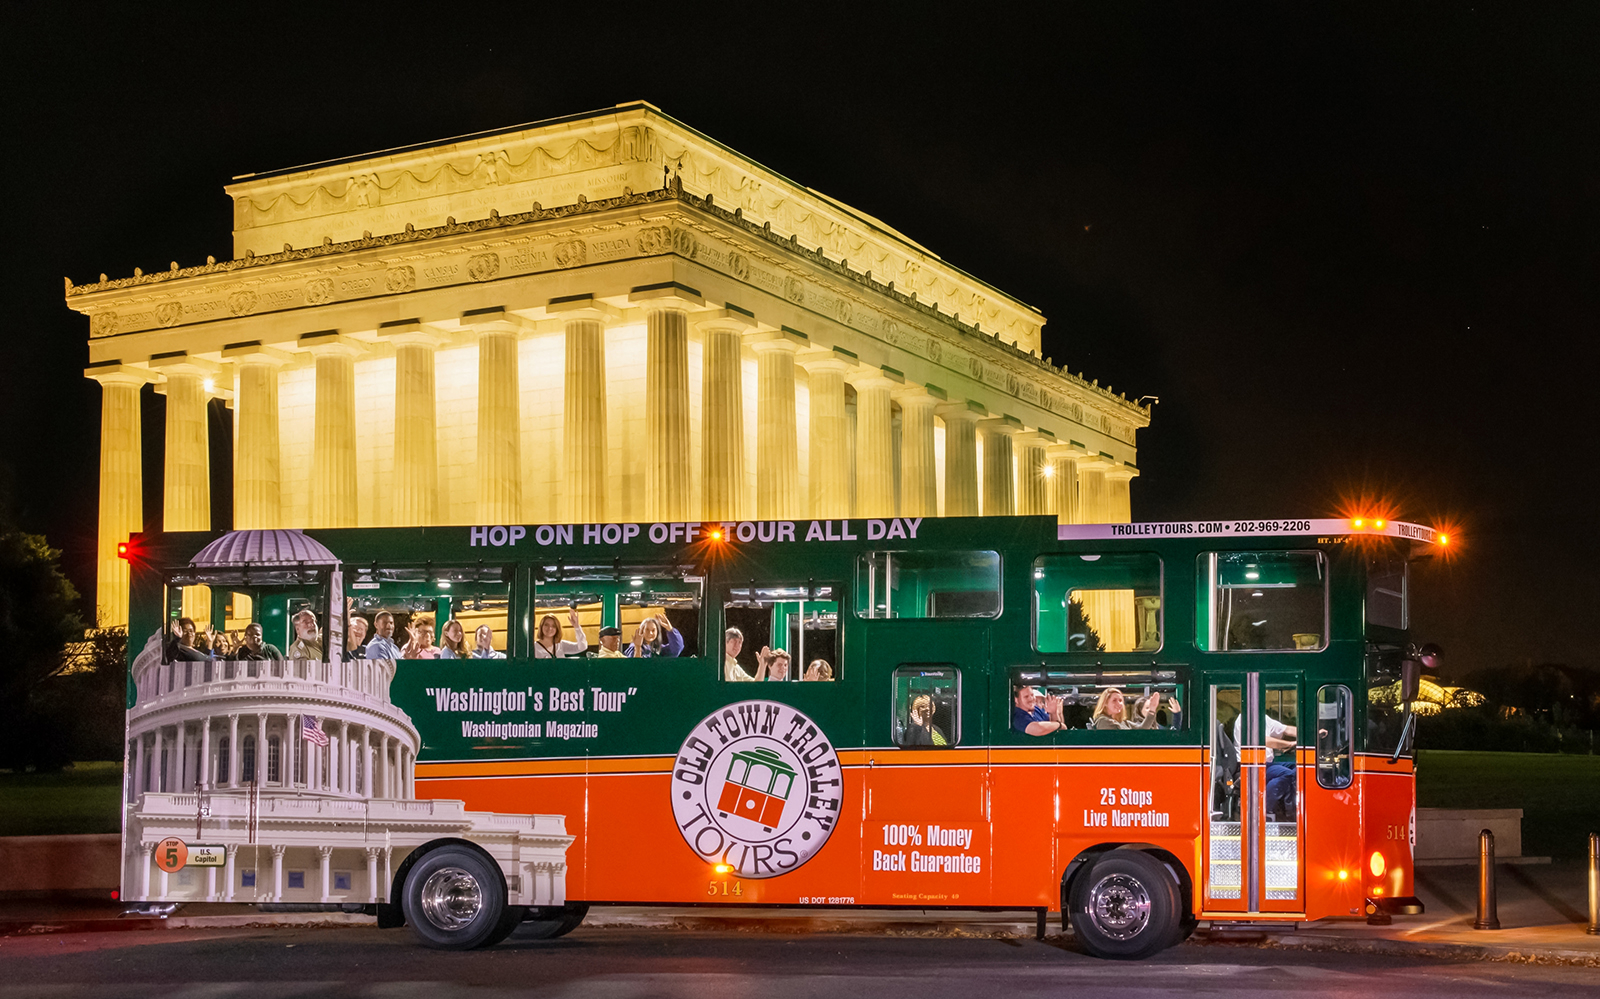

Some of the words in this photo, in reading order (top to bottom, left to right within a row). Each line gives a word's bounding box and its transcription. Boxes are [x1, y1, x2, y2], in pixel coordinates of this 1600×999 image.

[587, 172, 628, 187] MISSOURI
[410, 205, 451, 216] MISSSSIPPI
[592, 238, 631, 253] NEVADA
[504, 251, 548, 266] VIRGINIA
[423, 264, 459, 278] KANSAS
[340, 276, 377, 291] OREGON
[184, 300, 227, 314] CALIFORNIA
[470, 525, 526, 547] HOP
[535, 524, 574, 546] ON
[583, 523, 640, 545] HOP
[649, 522, 701, 544] OFF
[719, 521, 796, 543] TOUR
[805, 520, 857, 542] ALL
[867, 517, 923, 540] DAY
[1111, 523, 1223, 536] TROLLEYTOURS.COM
[1234, 521, 1311, 533] 202-969-2206
[549, 687, 585, 712] Best
[461, 721, 541, 740] Washingtonian
[546, 721, 598, 740] Magazine
[675, 736, 715, 785] OLD
[705, 704, 780, 744] TOWN
[783, 713, 839, 832] TROLLEY
[1100, 788, 1116, 806] 25
[1120, 788, 1152, 808] Stops
[1083, 809, 1109, 827] Live
[1112, 809, 1169, 828] Narration
[681, 802, 799, 874] TOURS
[882, 824, 922, 847] 100%
[927, 825, 973, 850] Money
[1387, 824, 1405, 840] 514
[166, 848, 178, 868] 5
[195, 855, 217, 863] Capitol
[872, 850, 906, 872] Back
[910, 852, 981, 874] Guarantee
[707, 881, 743, 896] 514
[799, 896, 809, 904] US
[811, 896, 826, 904] DOT
[892, 893, 917, 901] Seating
[918, 893, 948, 901] Capacity
